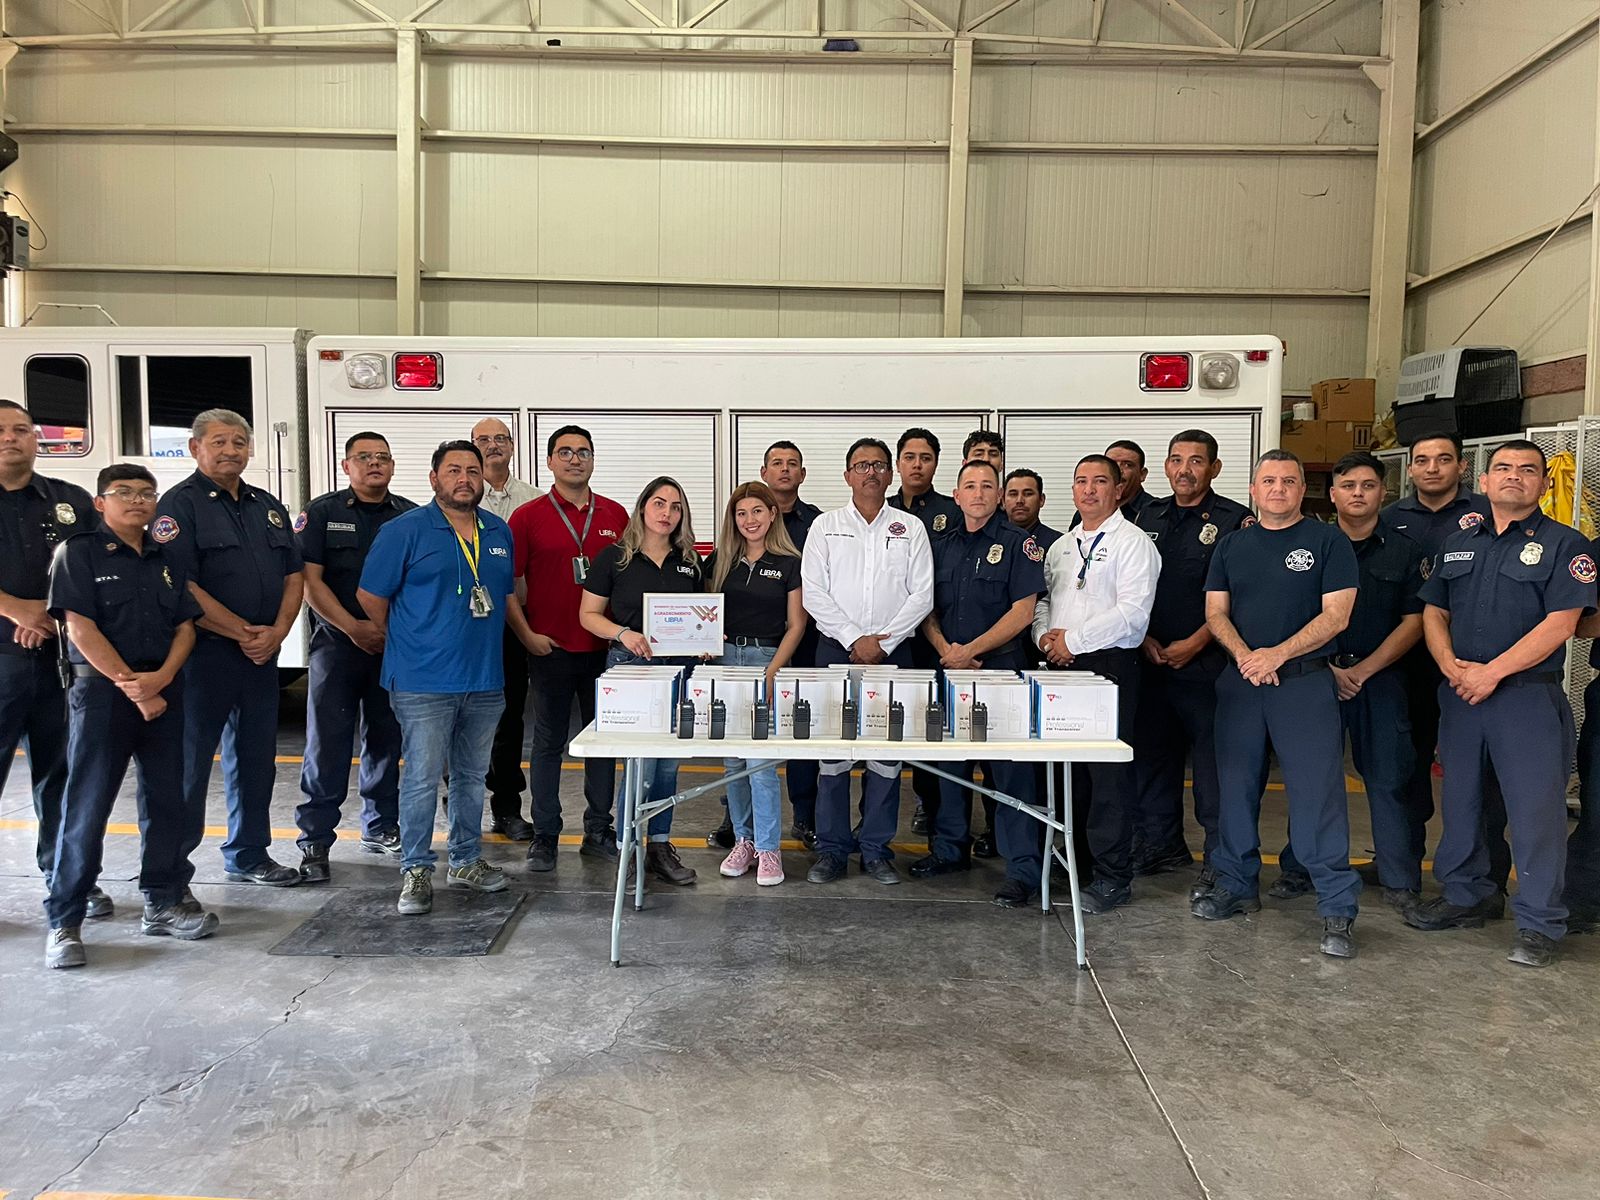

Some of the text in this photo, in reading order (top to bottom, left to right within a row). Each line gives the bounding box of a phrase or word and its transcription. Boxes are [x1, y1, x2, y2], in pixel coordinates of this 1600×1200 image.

[598, 529, 617, 538] LIBRA
[488, 547, 507, 555] LIBRA
[676, 565, 695, 576] LIBRA
[759, 568, 782, 578] LIBRA
[1046, 721, 1085, 729] Professional
